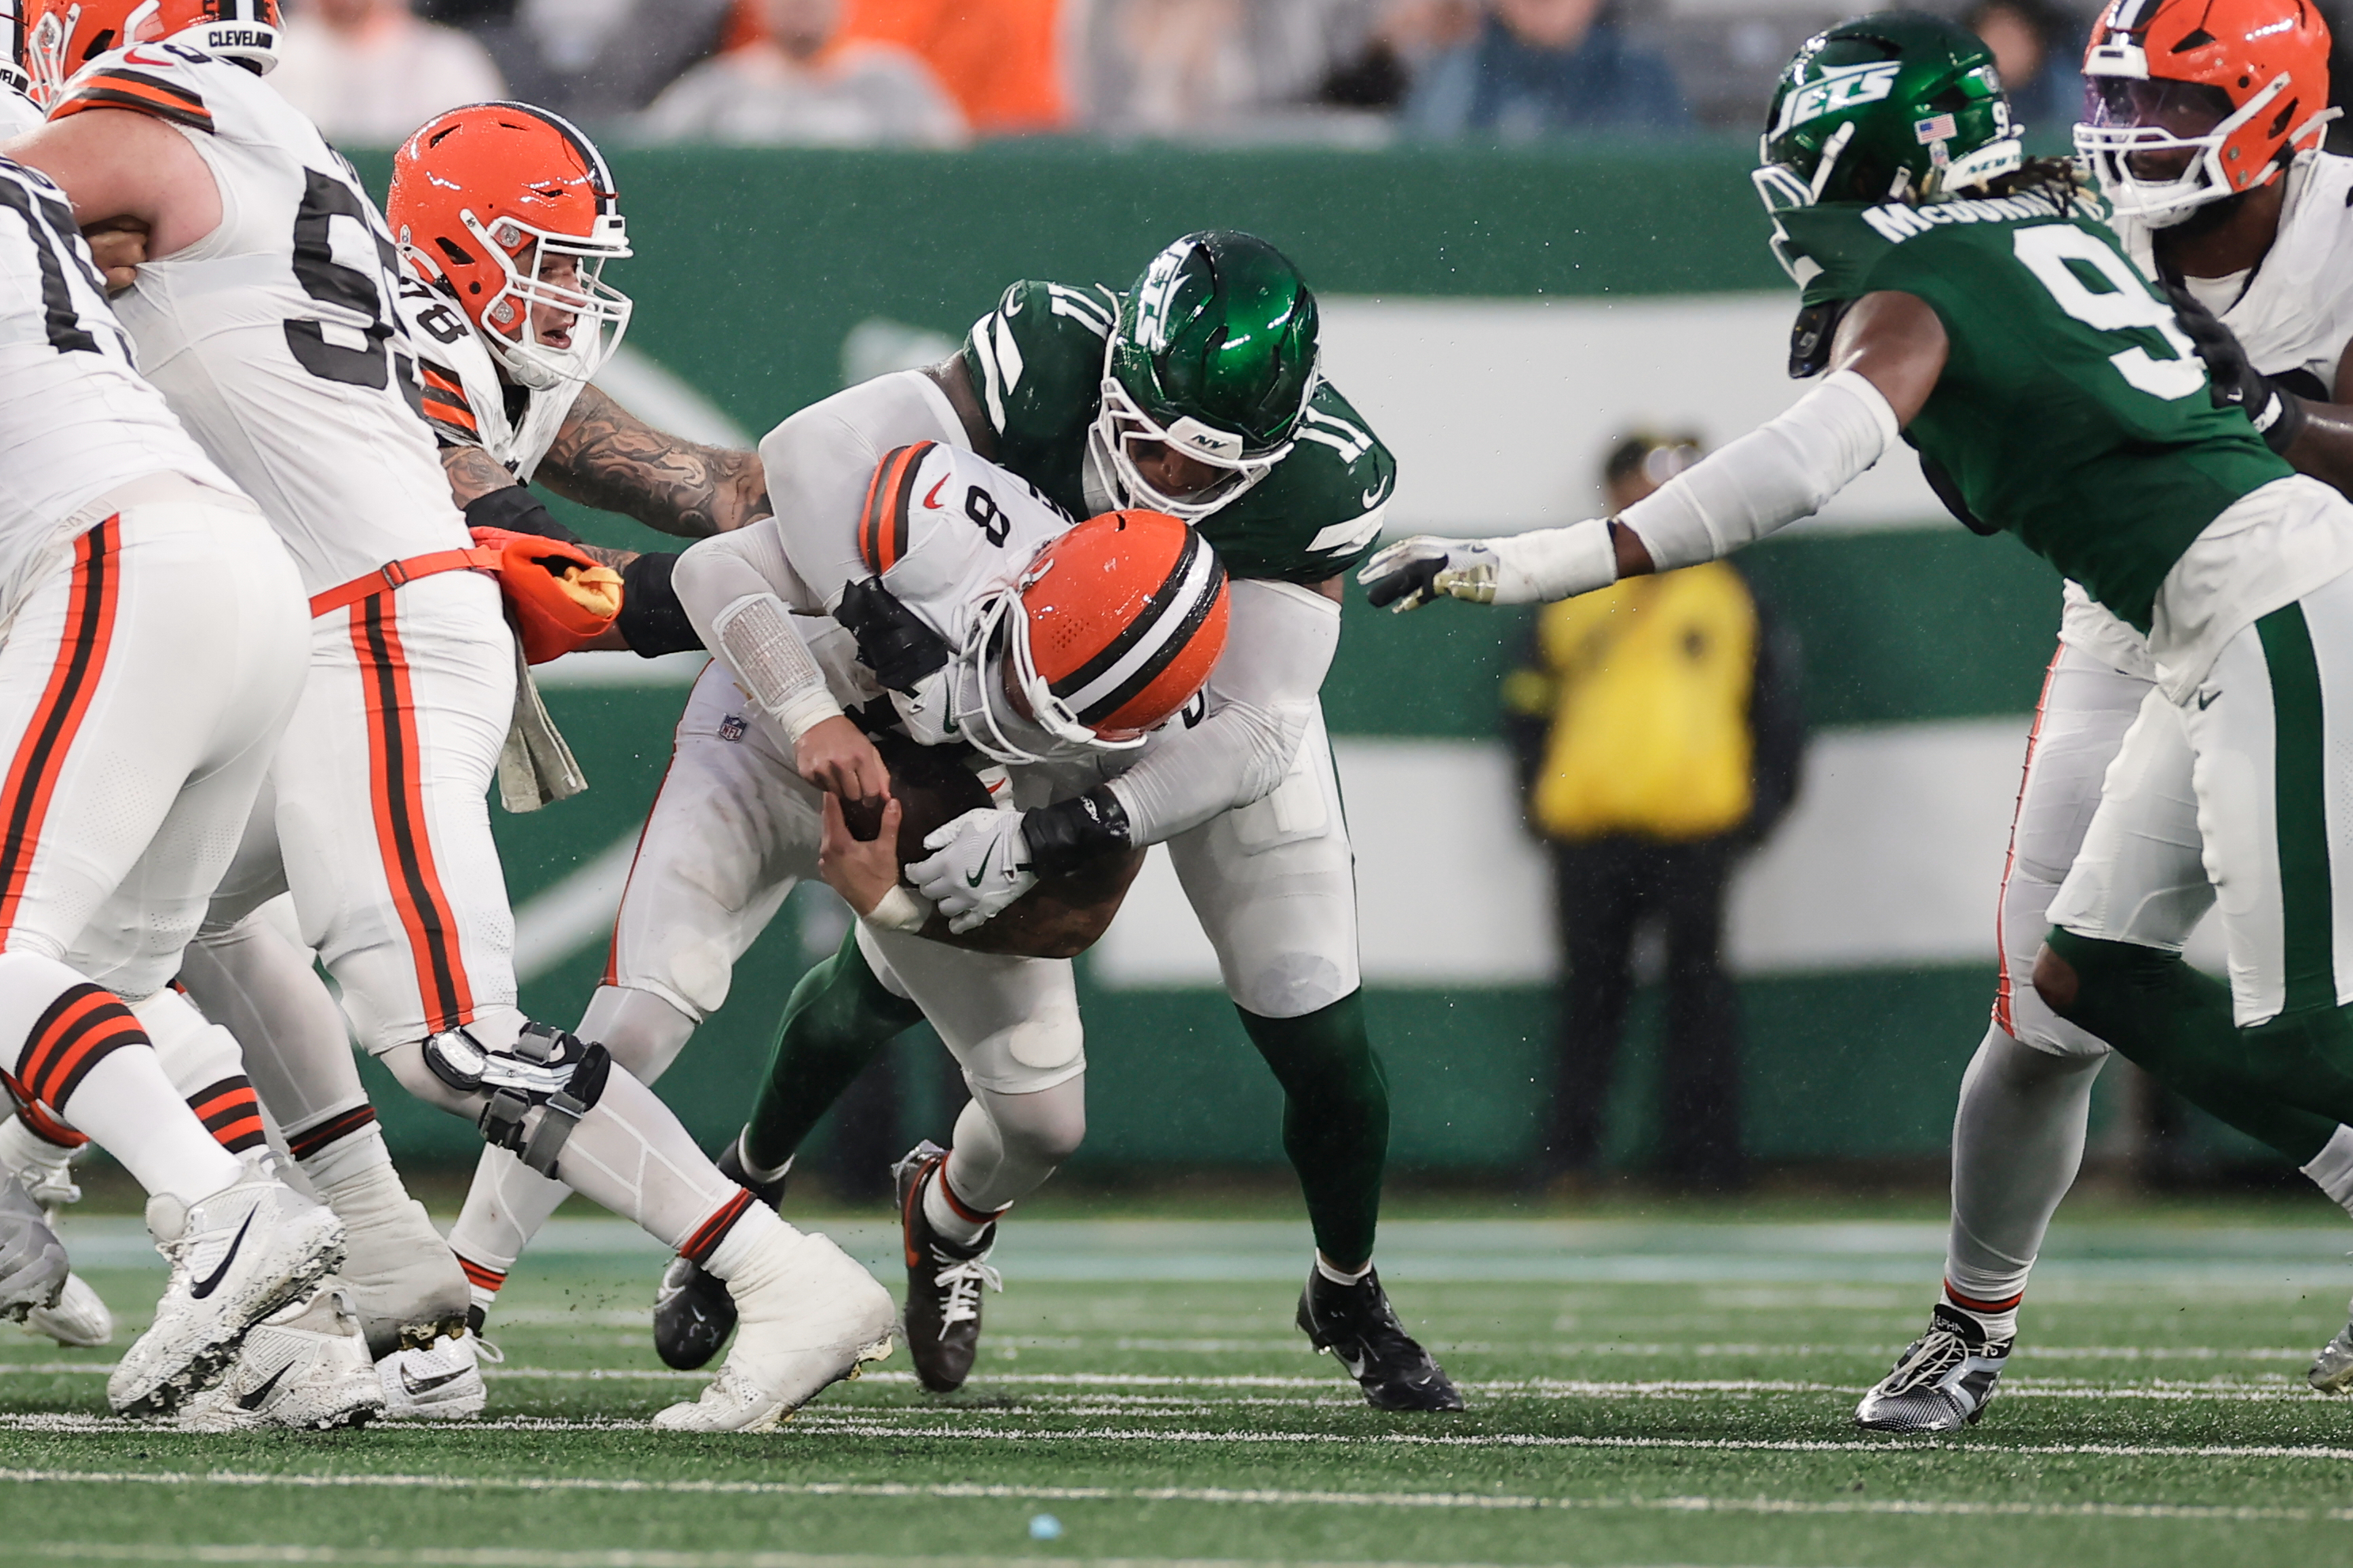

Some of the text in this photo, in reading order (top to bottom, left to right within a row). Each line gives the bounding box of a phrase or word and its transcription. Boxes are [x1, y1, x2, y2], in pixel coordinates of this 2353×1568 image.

[208, 30, 273, 49] CLEVEL
[1769, 61, 1902, 144] JETS
[1991, 101, 2009, 136] 9
[1047, 283, 1113, 340] 11
[2013, 223, 2207, 401] 9
[1191, 435, 1228, 449] NY
[1293, 406, 1374, 464] 11
[965, 485, 1010, 548] 8
[721, 724, 742, 738] NFL
